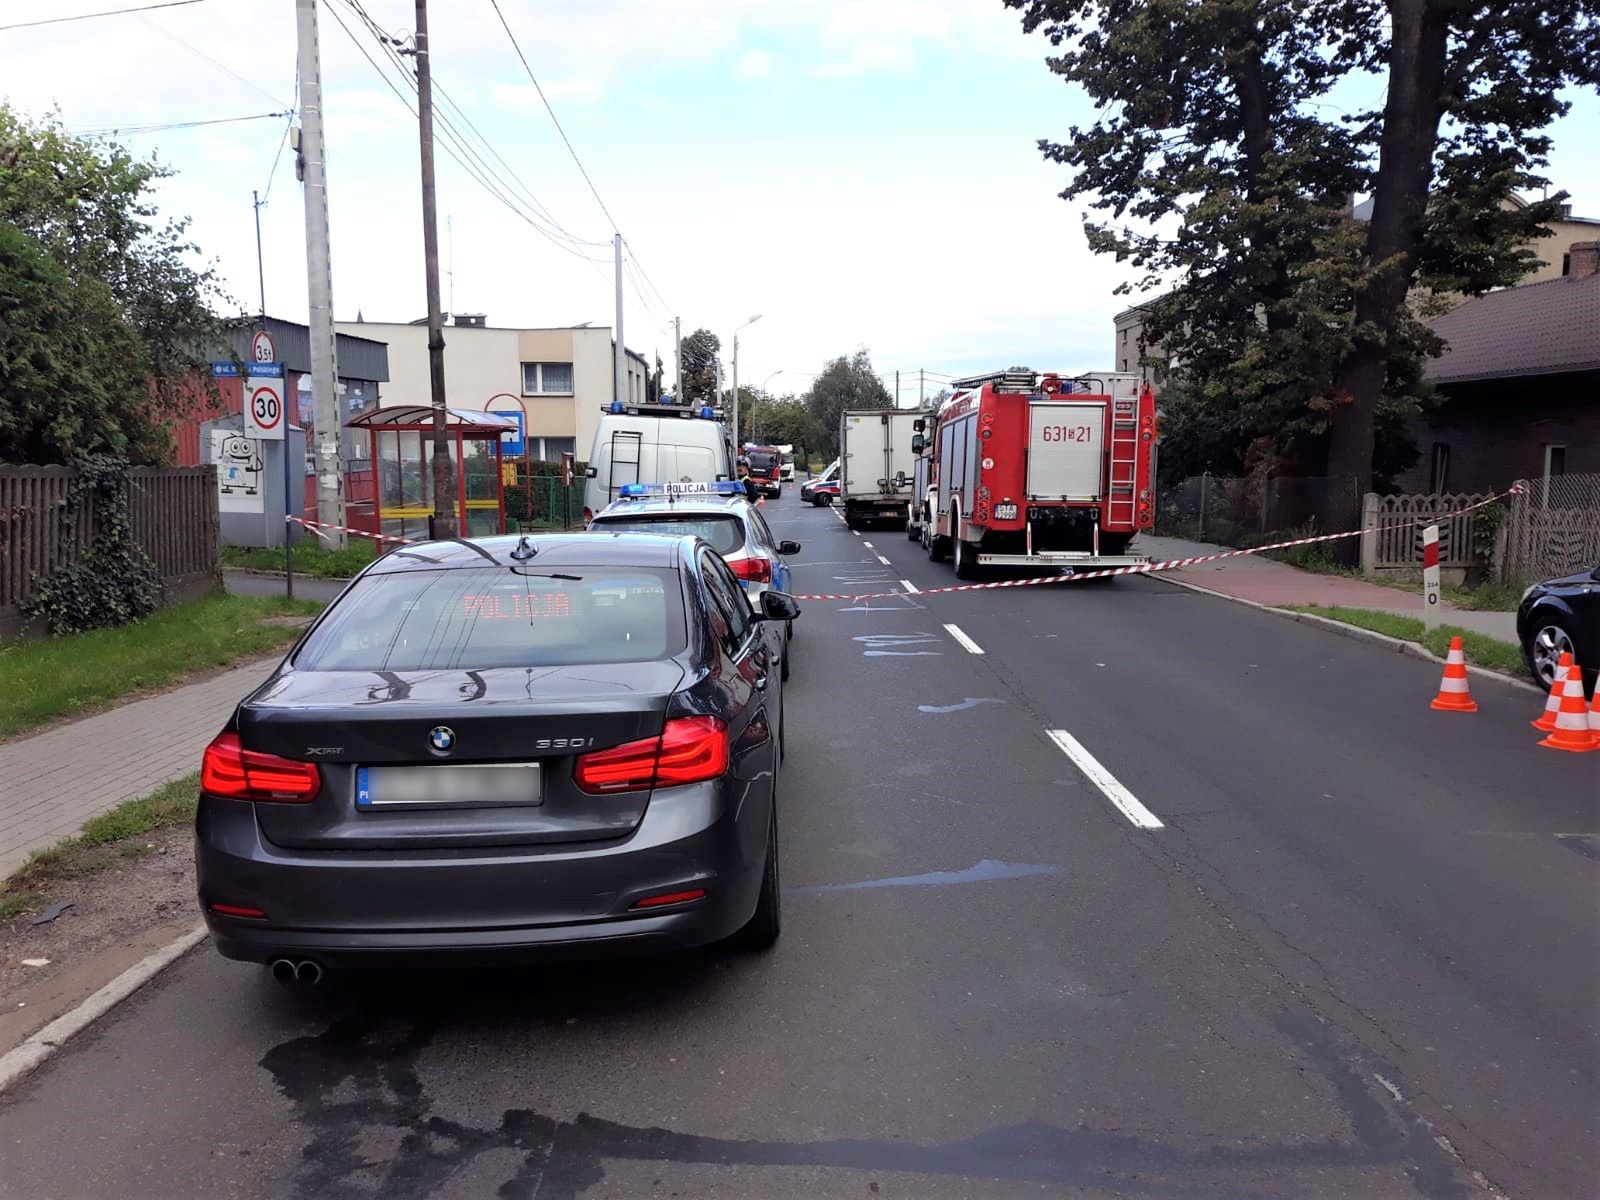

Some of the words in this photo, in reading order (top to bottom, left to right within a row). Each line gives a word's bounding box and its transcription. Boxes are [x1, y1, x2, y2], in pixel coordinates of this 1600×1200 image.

[256, 398, 277, 418] 30
[666, 484, 706, 494] POLICJA
[463, 592, 571, 619] POLICJA
